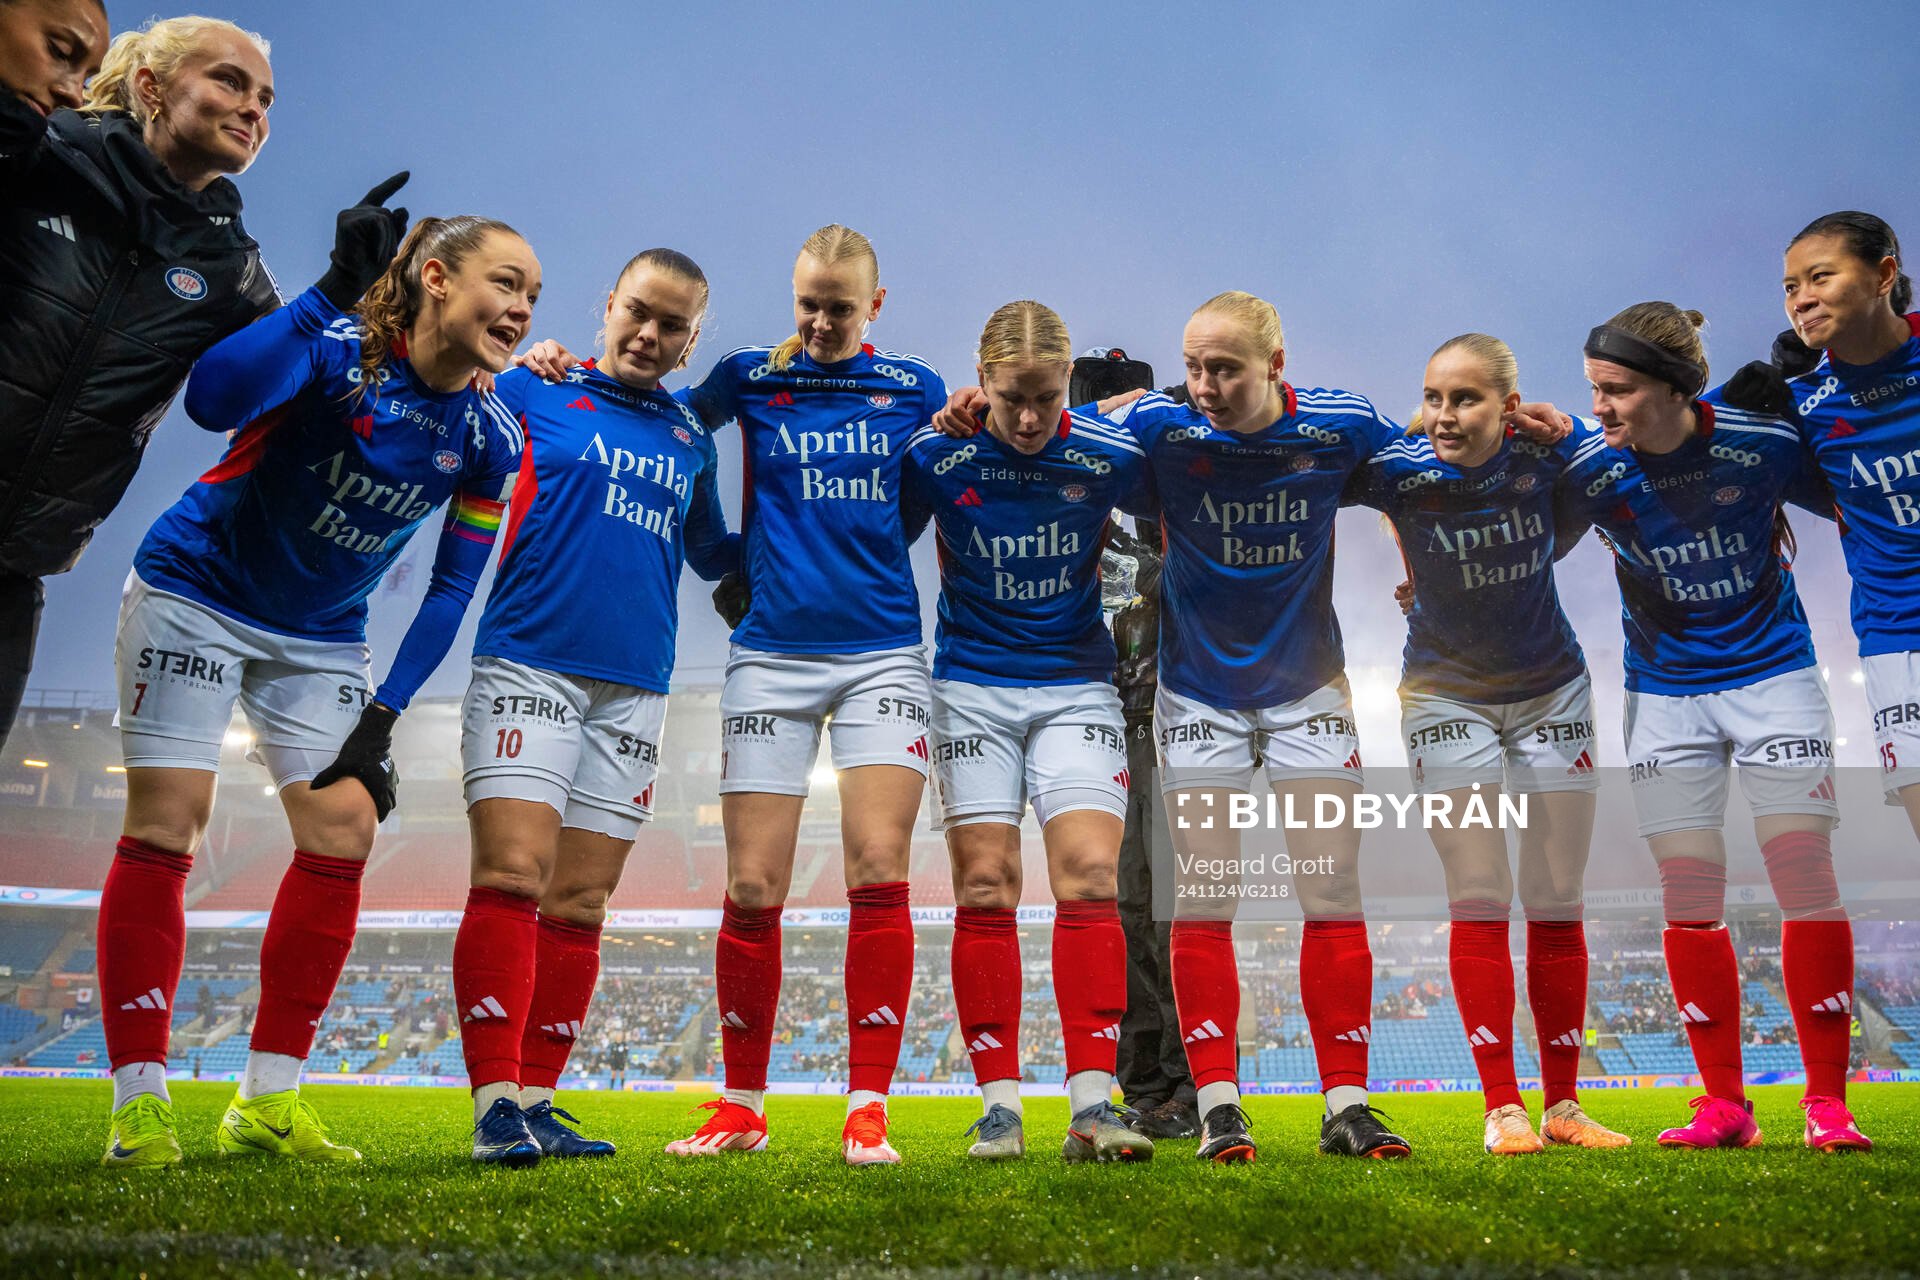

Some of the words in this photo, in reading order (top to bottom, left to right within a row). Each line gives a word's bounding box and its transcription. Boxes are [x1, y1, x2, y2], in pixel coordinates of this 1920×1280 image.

[873, 363, 918, 387] coop
[1798, 376, 1839, 416] coop
[768, 419, 891, 463] Aprila
[1167, 425, 1212, 443] coop
[1297, 423, 1341, 445] coop
[577, 431, 689, 500] Aprila
[933, 444, 977, 475] coop
[1064, 449, 1112, 475] coop
[1709, 445, 1762, 468] coop
[306, 450, 433, 520] Aprila
[800, 466, 888, 503] Bank
[981, 468, 1049, 485] Eidsiva.
[1398, 469, 1443, 492] coop
[1586, 462, 1627, 497] coop
[602, 481, 679, 544] Bank
[1192, 488, 1311, 533] Aprila
[1886, 494, 1920, 528] B
[965, 520, 1080, 568] Aprila
[1221, 532, 1305, 566] Bank
[1427, 506, 1545, 561] Aprila
[1631, 525, 1748, 574] Aprila
[993, 565, 1073, 600] Bank
[1661, 564, 1756, 602] Bank
[131, 683, 148, 716] 7
[495, 728, 523, 759] 10
[1880, 742, 1897, 774] 15
[1415, 756, 1425, 784] 4
[621, 914, 646, 924] Norsk
[648, 914, 679, 926] Tipping
